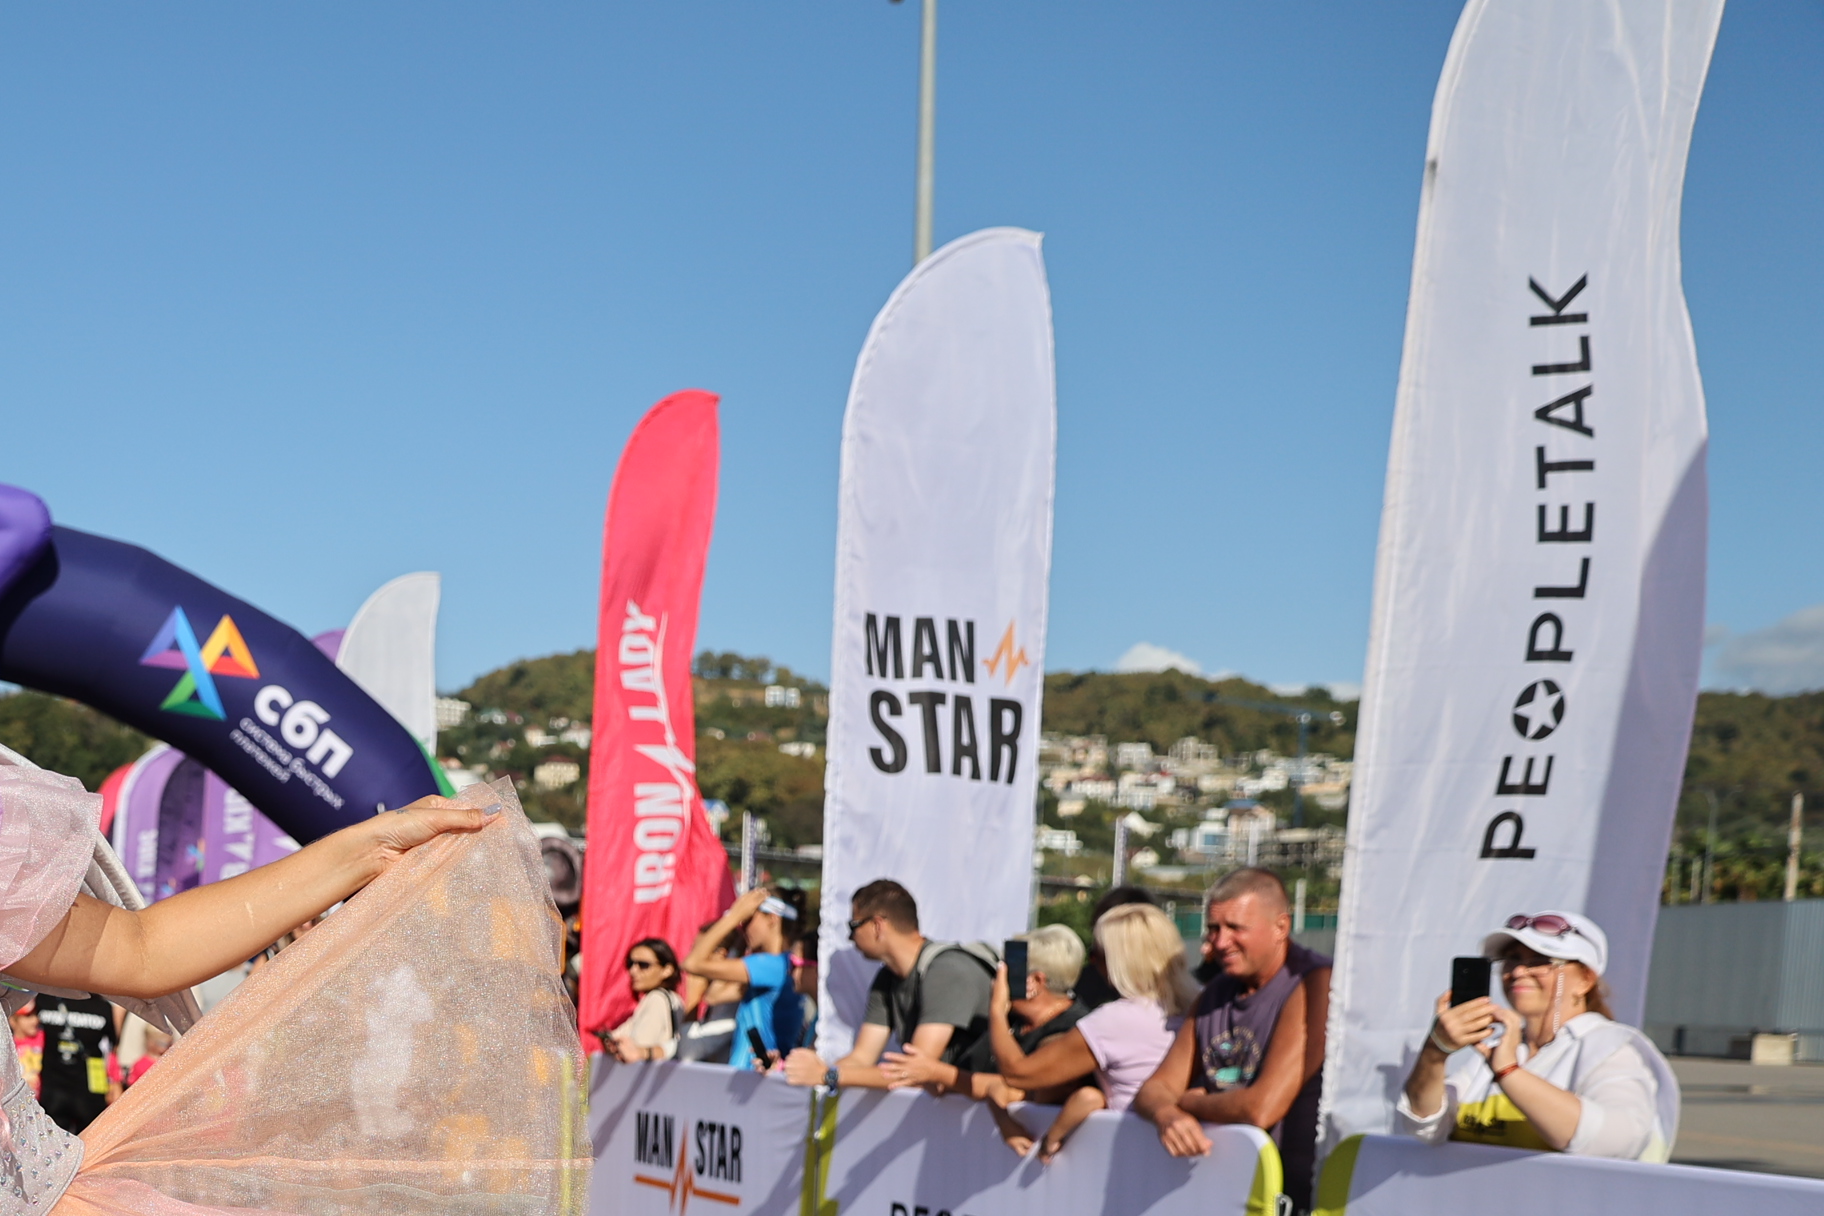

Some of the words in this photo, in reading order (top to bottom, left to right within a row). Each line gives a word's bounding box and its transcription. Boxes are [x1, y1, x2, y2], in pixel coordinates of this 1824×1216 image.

[1478, 272, 1596, 862] PEOPLETALK
[618, 597, 667, 721] LADY
[865, 612, 975, 684] MAN
[253, 684, 354, 779] сбп
[868, 689, 1023, 785] STAR
[633, 782, 685, 904] IRON
[635, 1110, 674, 1169] MAN
[695, 1119, 742, 1184] STAR
